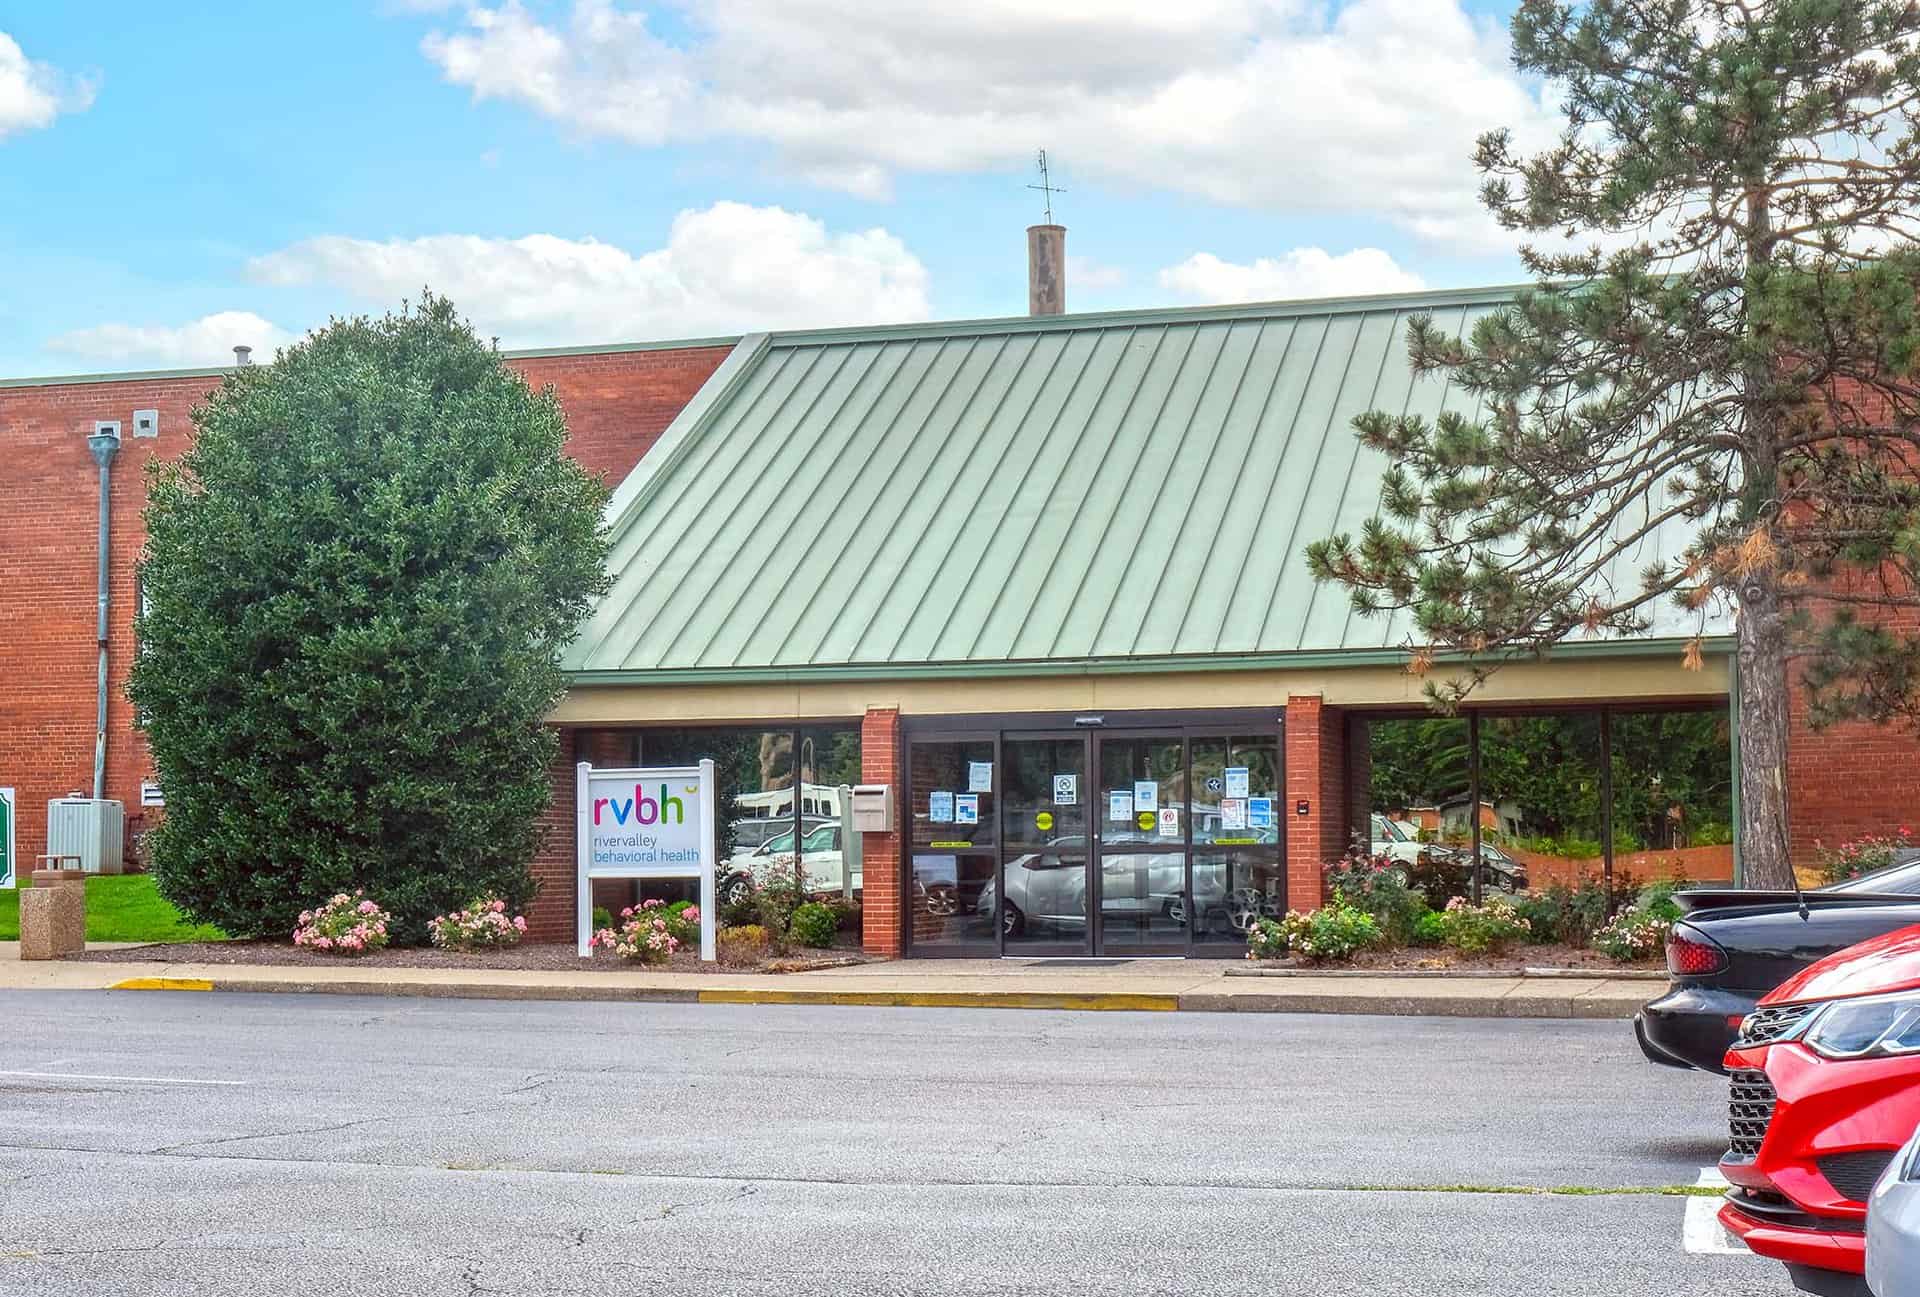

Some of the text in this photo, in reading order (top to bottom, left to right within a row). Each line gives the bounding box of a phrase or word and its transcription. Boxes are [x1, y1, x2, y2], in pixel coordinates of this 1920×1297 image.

[594, 783, 684, 826] rvbh
[594, 848, 699, 863] behavioral health
